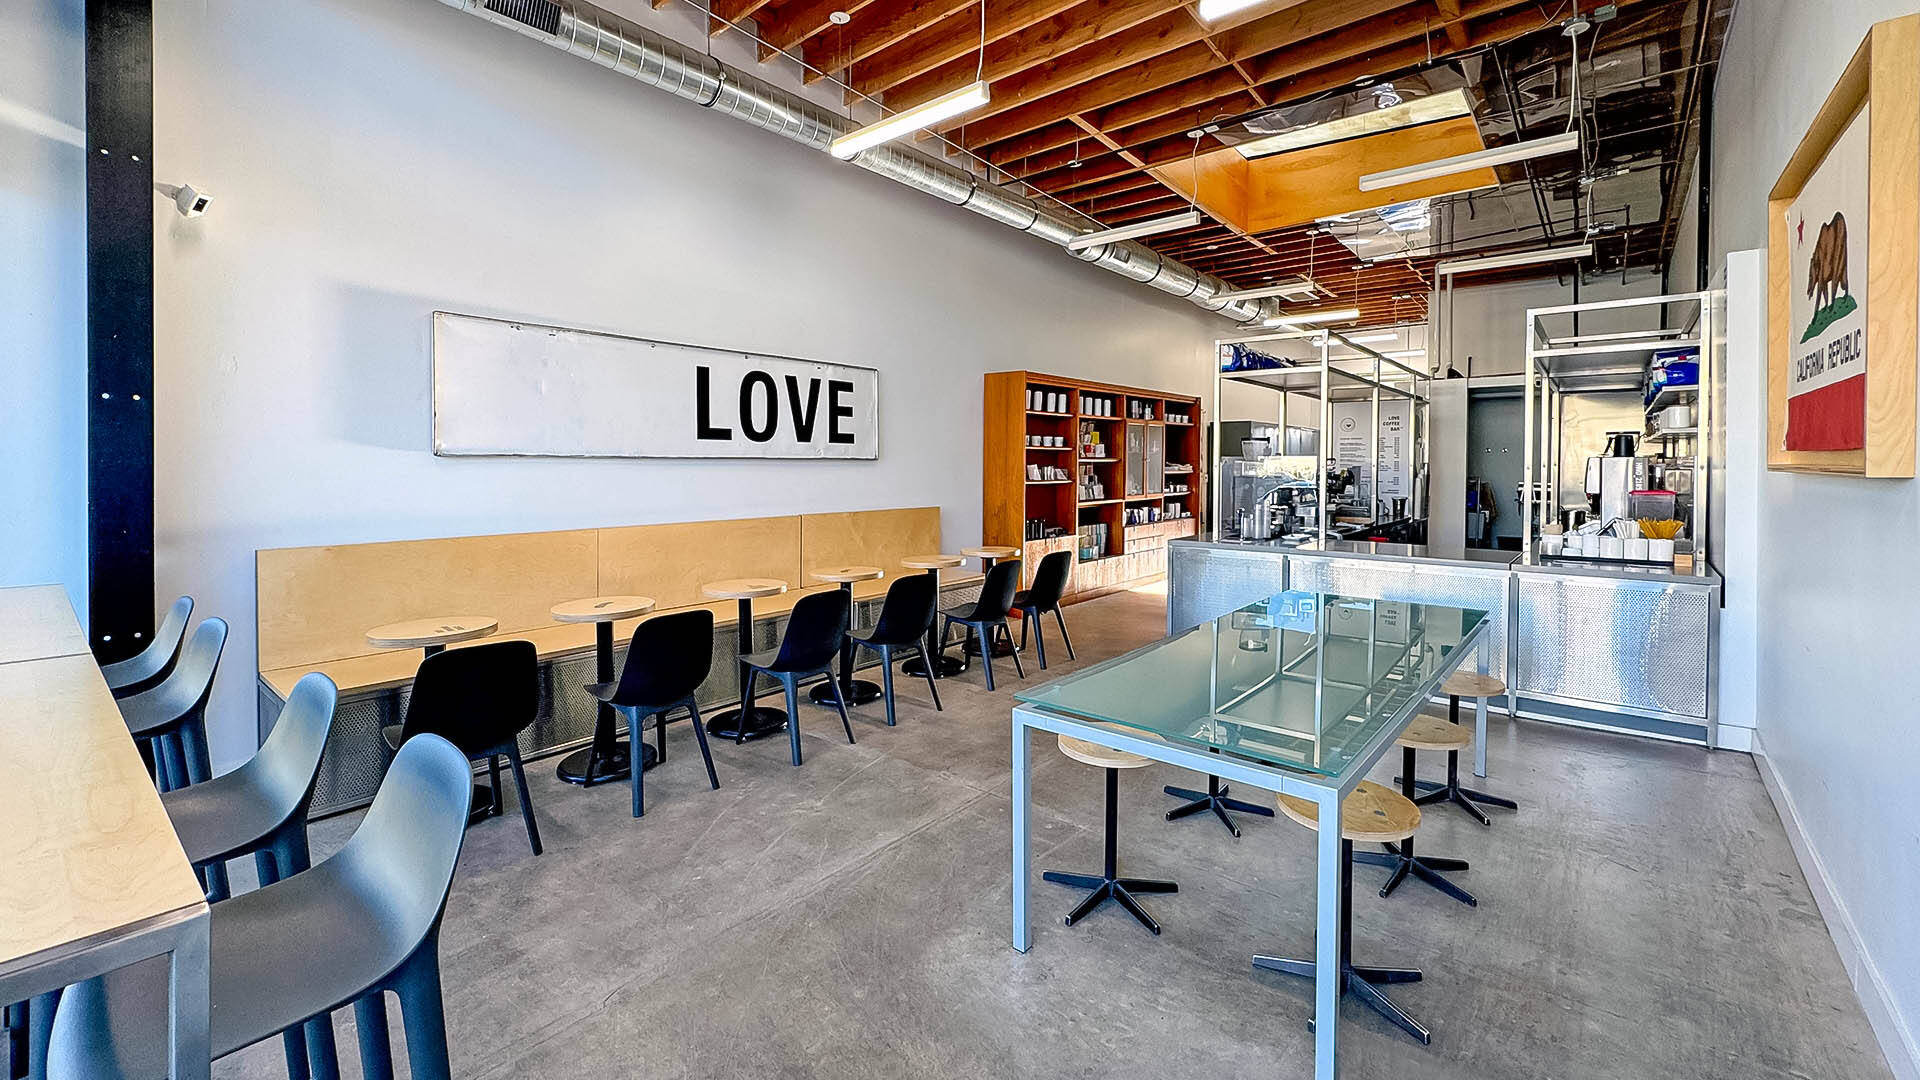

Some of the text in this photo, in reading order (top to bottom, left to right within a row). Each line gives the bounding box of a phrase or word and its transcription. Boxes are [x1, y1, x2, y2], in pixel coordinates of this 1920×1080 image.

[1797, 329, 1861, 382] CALIFORNIA REPUBLIC
[696, 365, 855, 444] LOVE
